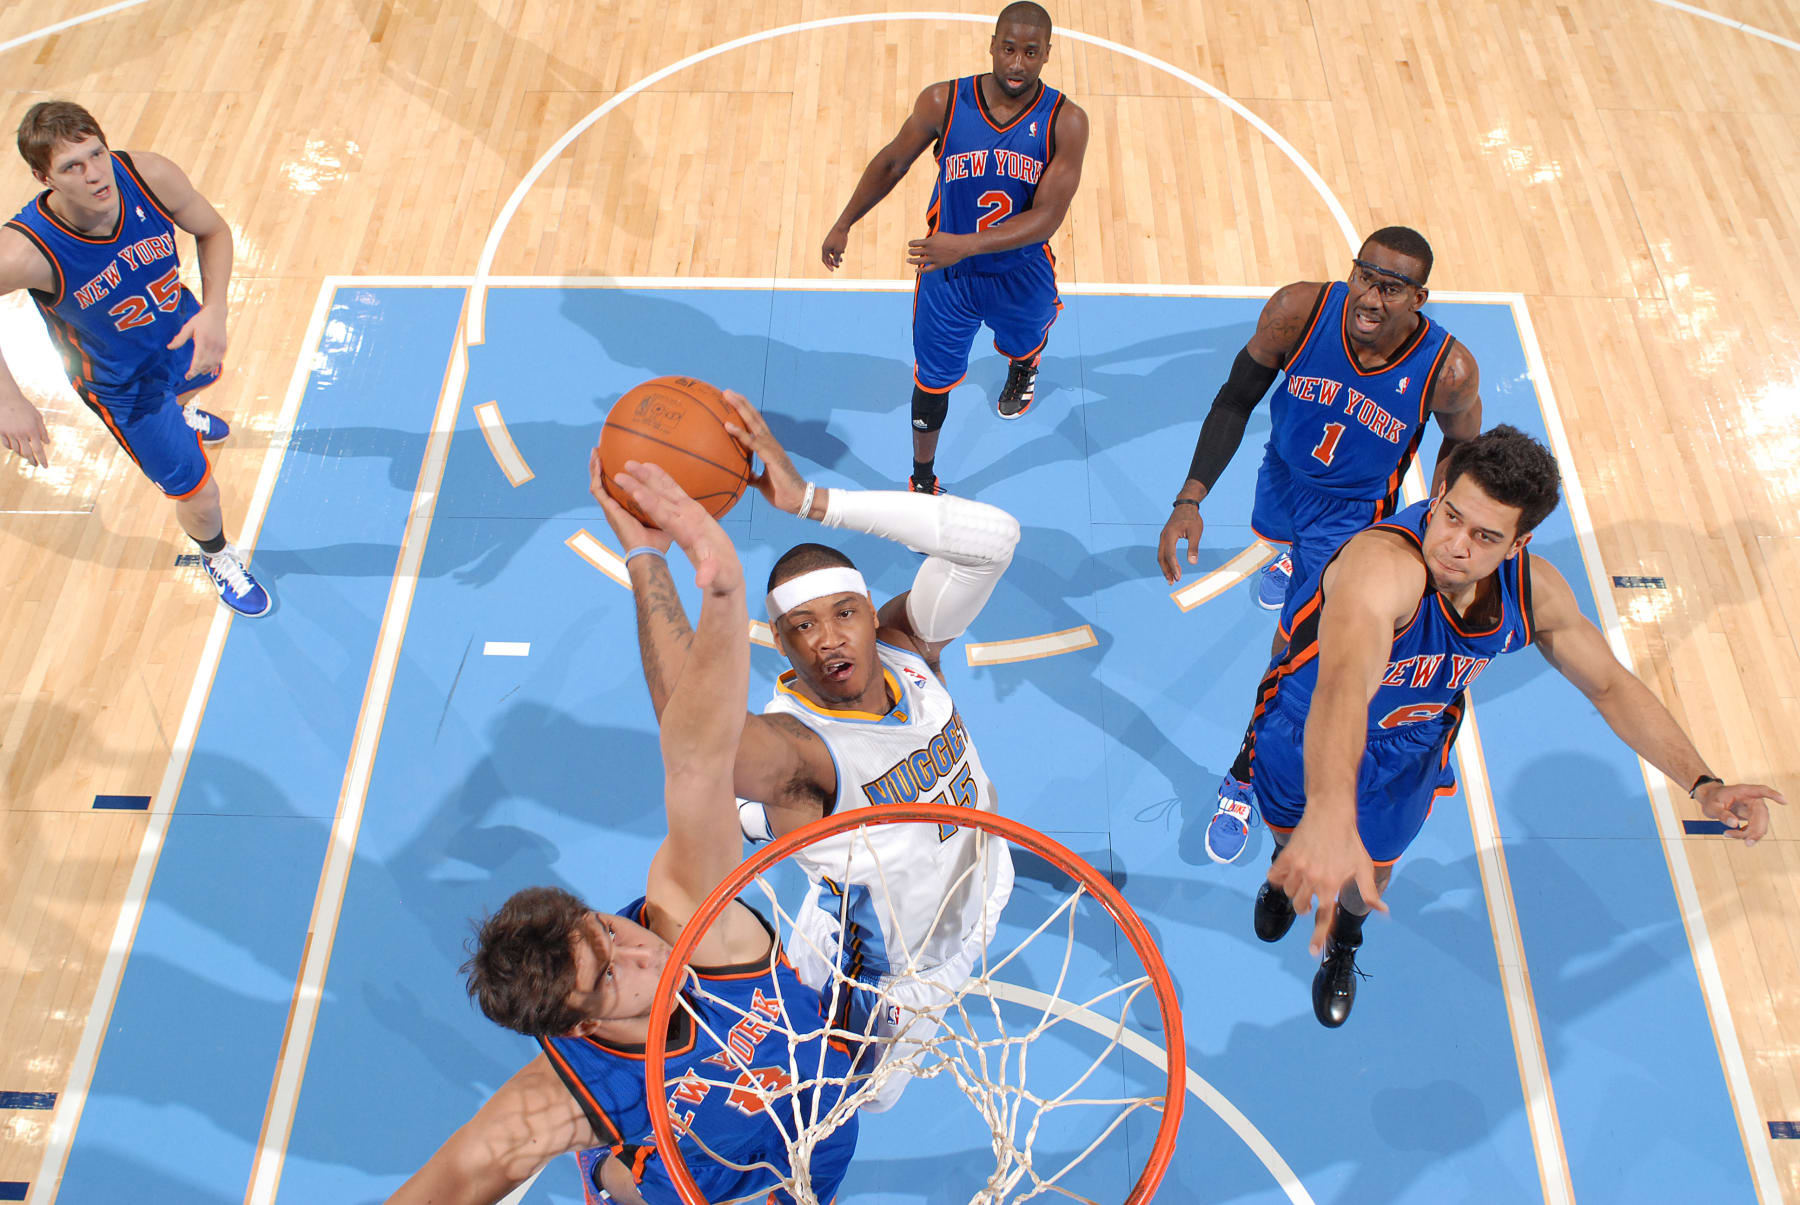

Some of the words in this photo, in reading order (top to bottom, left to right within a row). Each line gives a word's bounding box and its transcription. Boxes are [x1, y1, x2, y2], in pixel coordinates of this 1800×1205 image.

[946, 150, 988, 184] NEW
[976, 190, 1013, 233] 2
[73, 259, 123, 310] NEW
[108, 265, 182, 332] 25
[1287, 374, 1343, 406] NEW
[1343, 387, 1408, 445] YORK
[1311, 421, 1347, 467] 1
[1381, 652, 1446, 689] EW
[1446, 653, 1495, 689] YO
[860, 704, 969, 808] NUGGE
[642, 1066, 711, 1144] EW
